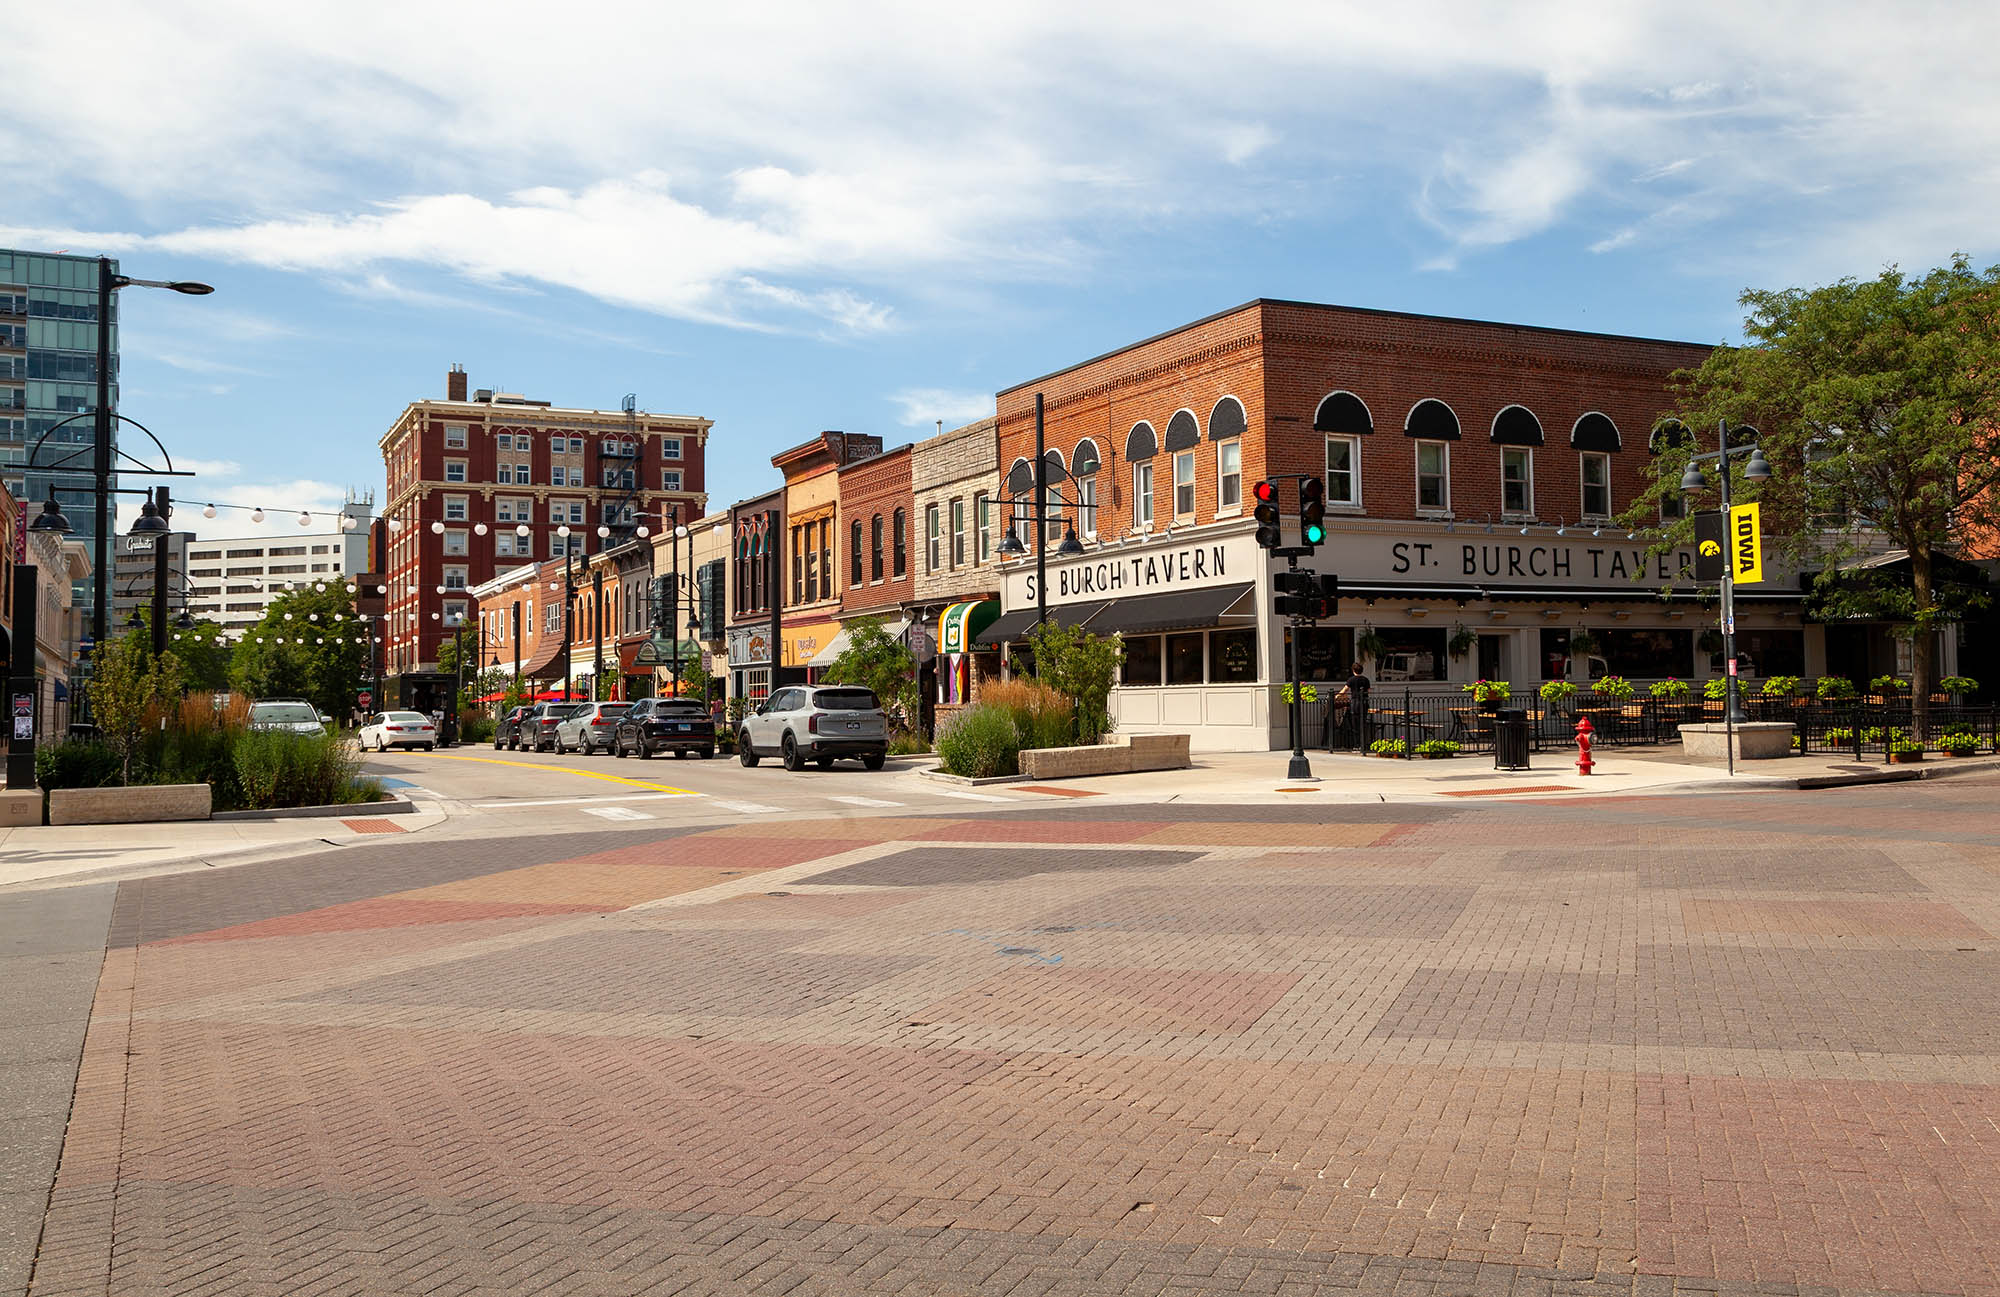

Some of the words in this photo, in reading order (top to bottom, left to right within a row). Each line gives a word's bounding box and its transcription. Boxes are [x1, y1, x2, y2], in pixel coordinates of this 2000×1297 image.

[1391, 542, 1439, 574] ST.
[1462, 545, 1572, 577] BURCH
[1587, 548, 1696, 581] TAVER
[1738, 513, 1754, 575] IOWA
[1026, 573, 1049, 601] S.
[1060, 560, 1122, 597] BURCH
[1131, 545, 1226, 587] TAVERN
